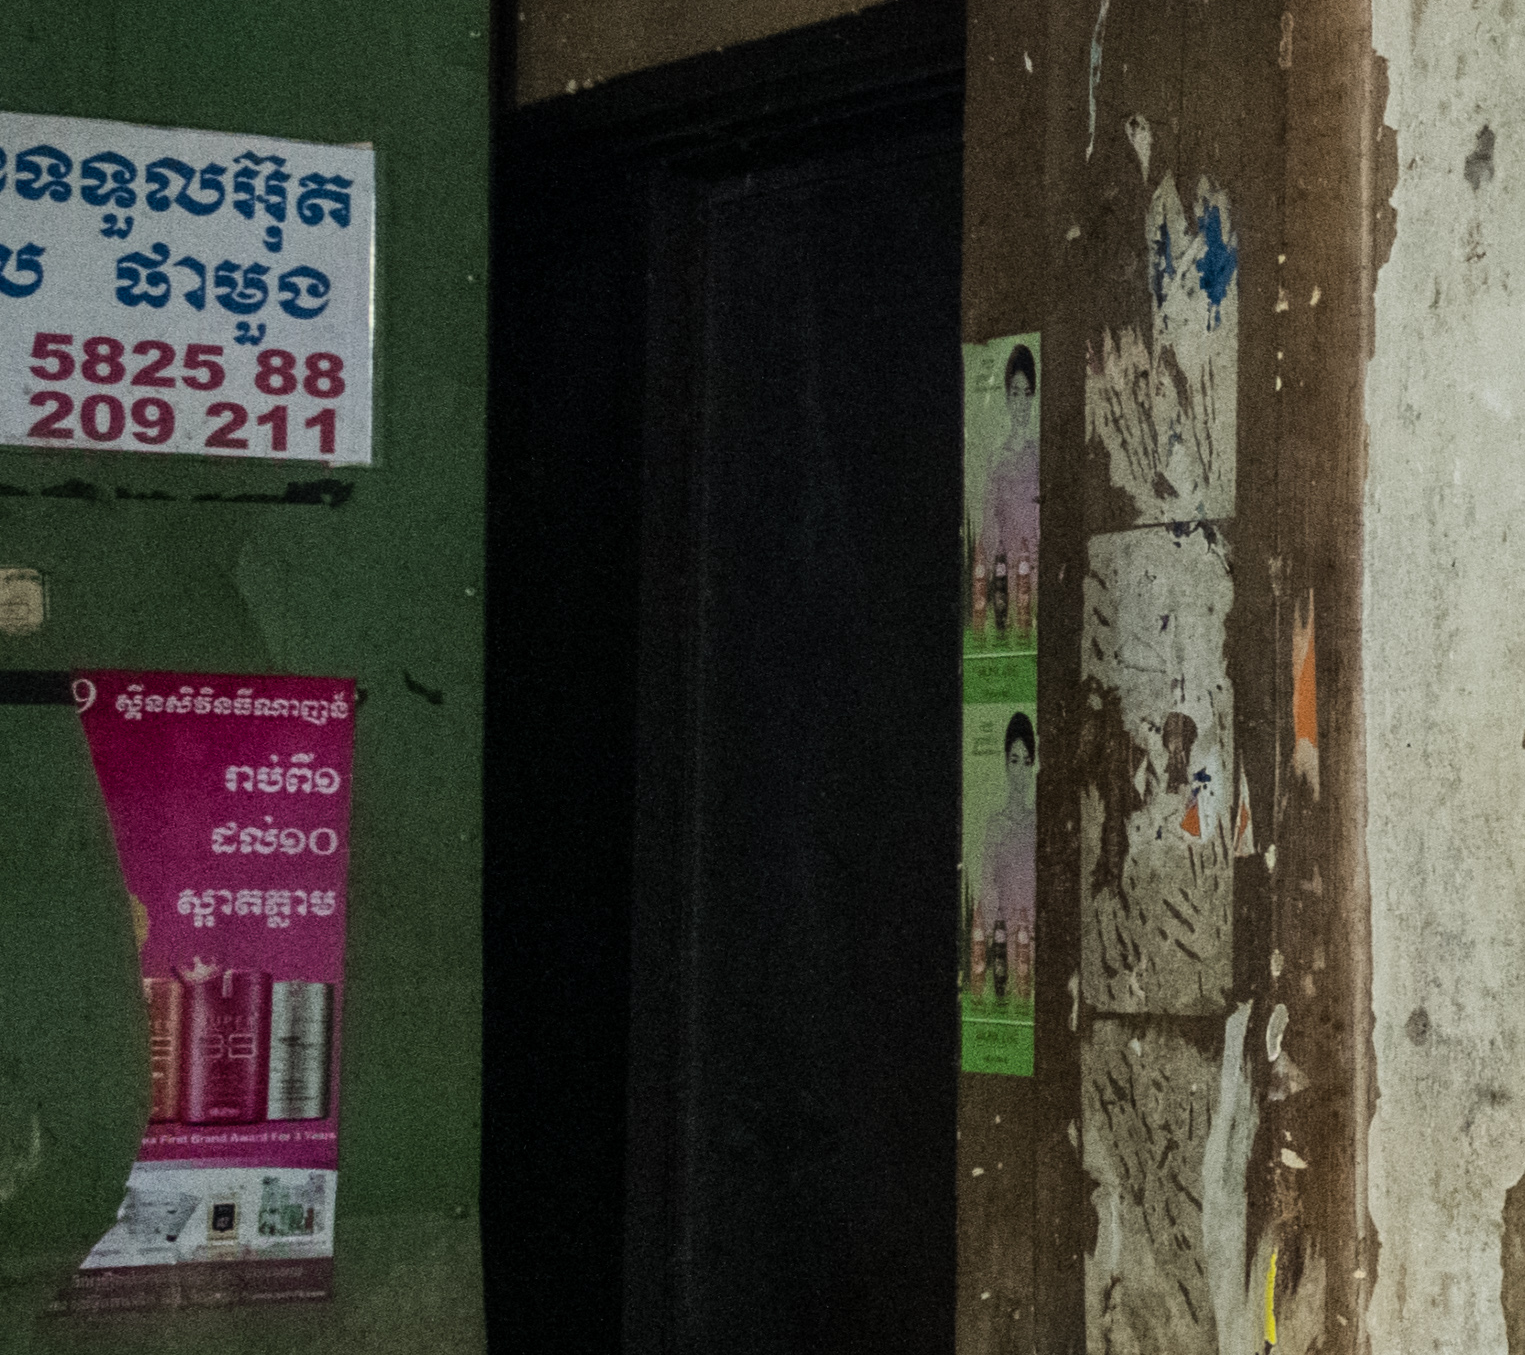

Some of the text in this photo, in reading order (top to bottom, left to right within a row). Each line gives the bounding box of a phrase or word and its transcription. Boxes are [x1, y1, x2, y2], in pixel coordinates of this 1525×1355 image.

[29, 331, 348, 400] 5825 88
[26, 390, 338, 455] 209 211
